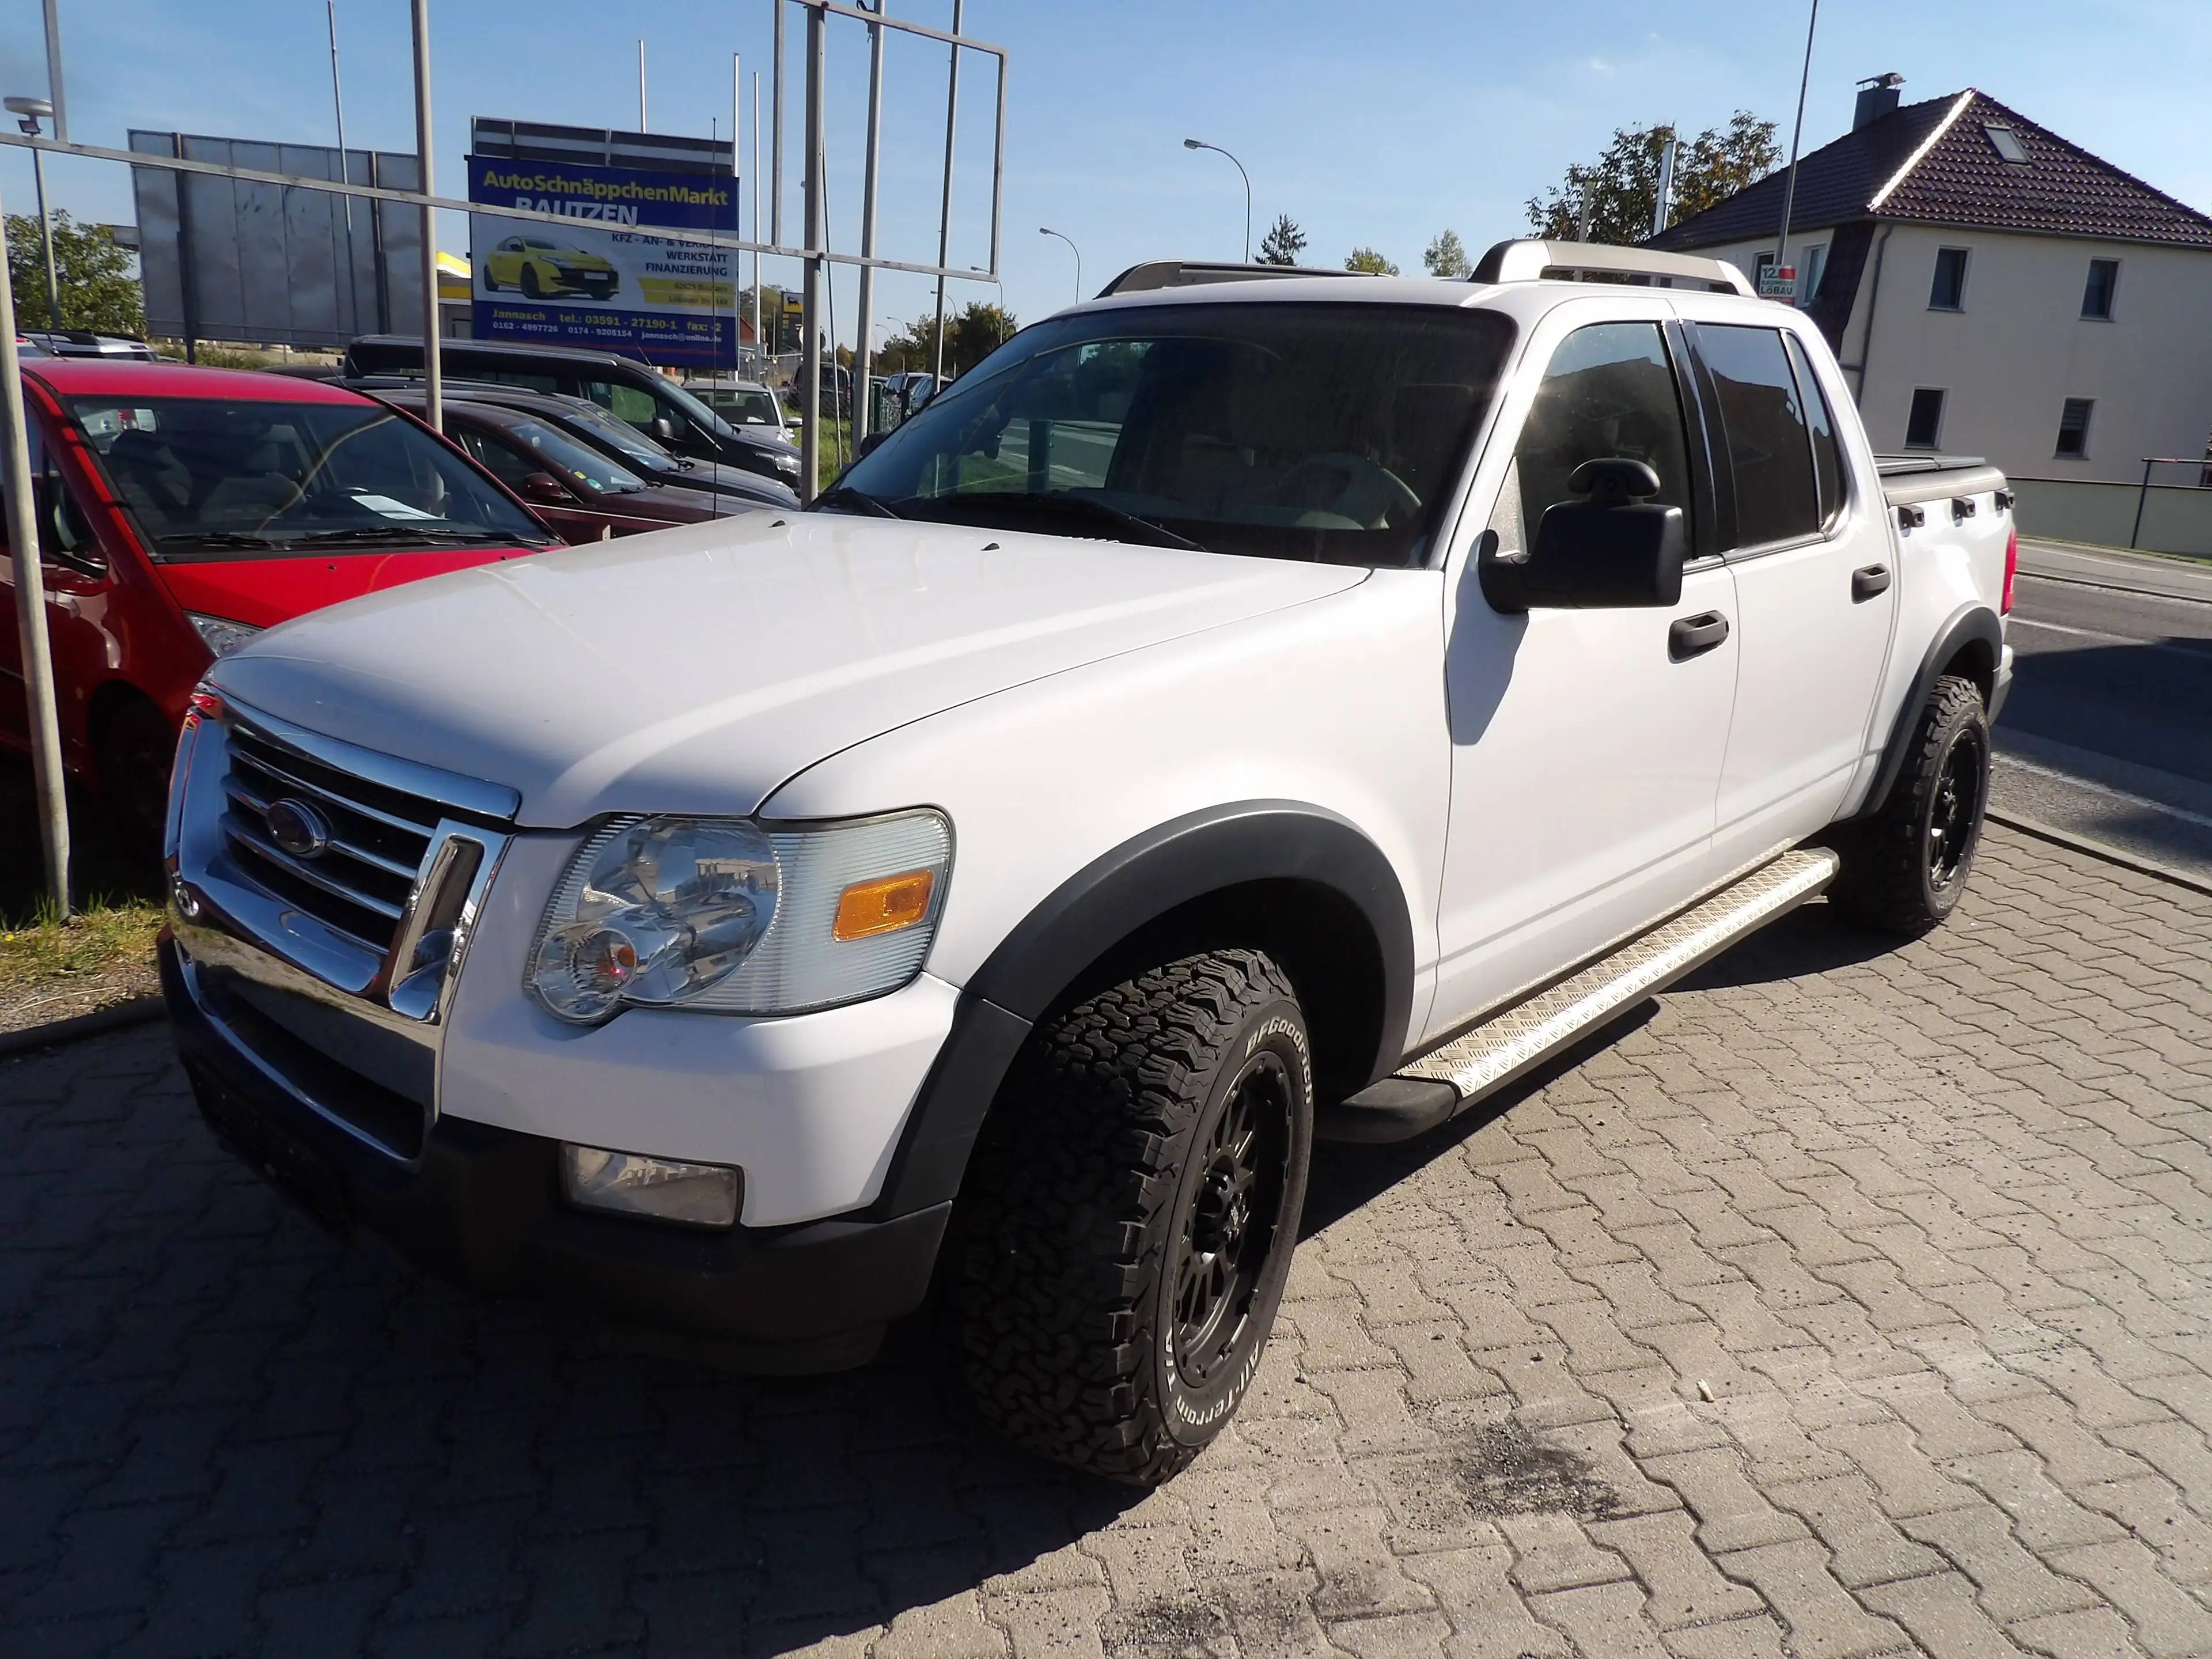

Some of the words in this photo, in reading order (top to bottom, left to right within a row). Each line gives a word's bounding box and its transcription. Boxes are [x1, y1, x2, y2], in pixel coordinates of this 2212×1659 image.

[483, 171, 728, 206] AutoSchnäppchenMarkt
[516, 196, 638, 226] BAUTZEN
[612, 233, 632, 243] KFZ
[646, 263, 727, 276] FINANZIERUNG
[666, 251, 728, 263] WERKSTATT
[492, 309, 546, 321] Jannasch
[560, 314, 582, 323] tel.:
[585, 316, 620, 326] 03591
[631, 319, 677, 330] 27190-1
[687, 321, 707, 331] fax:
[1245, 1016, 1312, 1104] BFGoodrich
[1177, 1339, 1259, 1426] All-Terrain
